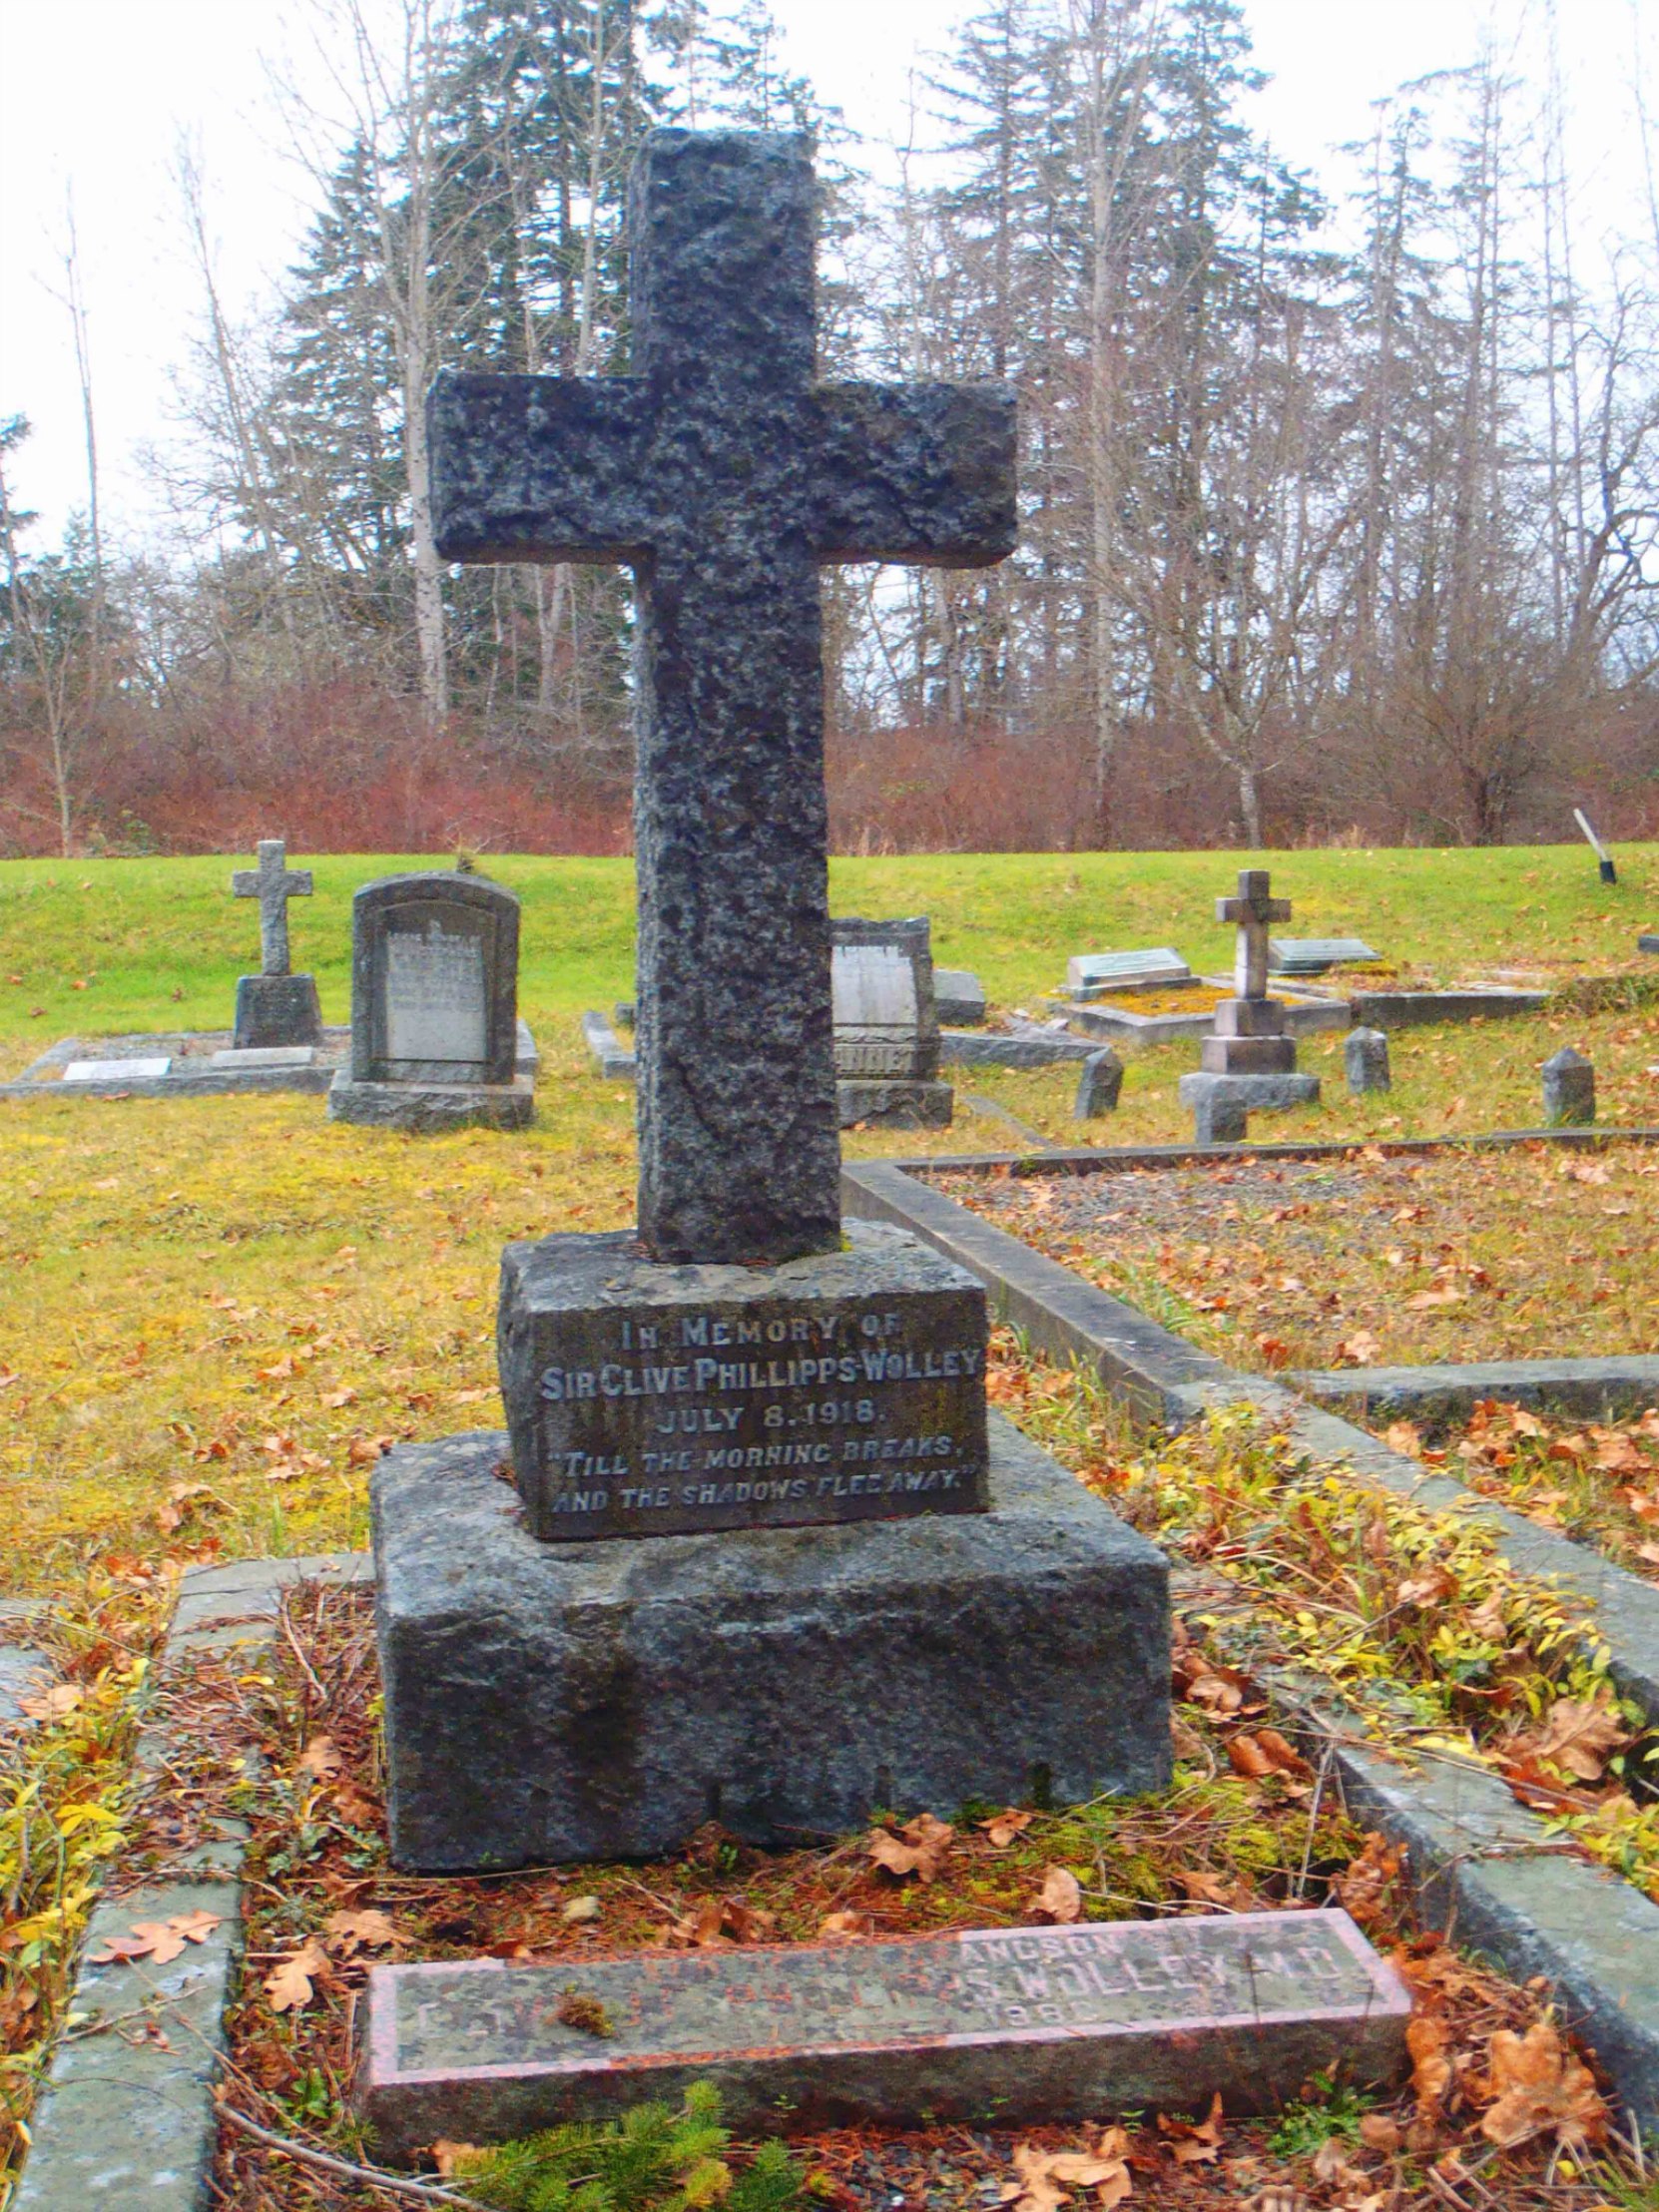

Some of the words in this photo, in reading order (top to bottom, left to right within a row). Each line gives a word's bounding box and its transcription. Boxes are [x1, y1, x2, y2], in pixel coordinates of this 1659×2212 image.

[621, 1320, 659, 1349] IN
[680, 1316, 838, 1347] MEMORY
[860, 1313, 899, 1337] OF
[540, 1367, 597, 1399] SIR
[600, 1364, 691, 1396] CLIVE
[655, 1406, 745, 1433] JULY
[641, 1450, 695, 1473] THE
[703, 1443, 831, 1470] MORNING
[551, 1490, 610, 1513] AND
[621, 1486, 671, 1509] THE
[681, 1478, 811, 1505] SHADOWS
[815, 1473, 884, 1497] FLEE
[1010, 1953, 1228, 1999] WOLLEY
